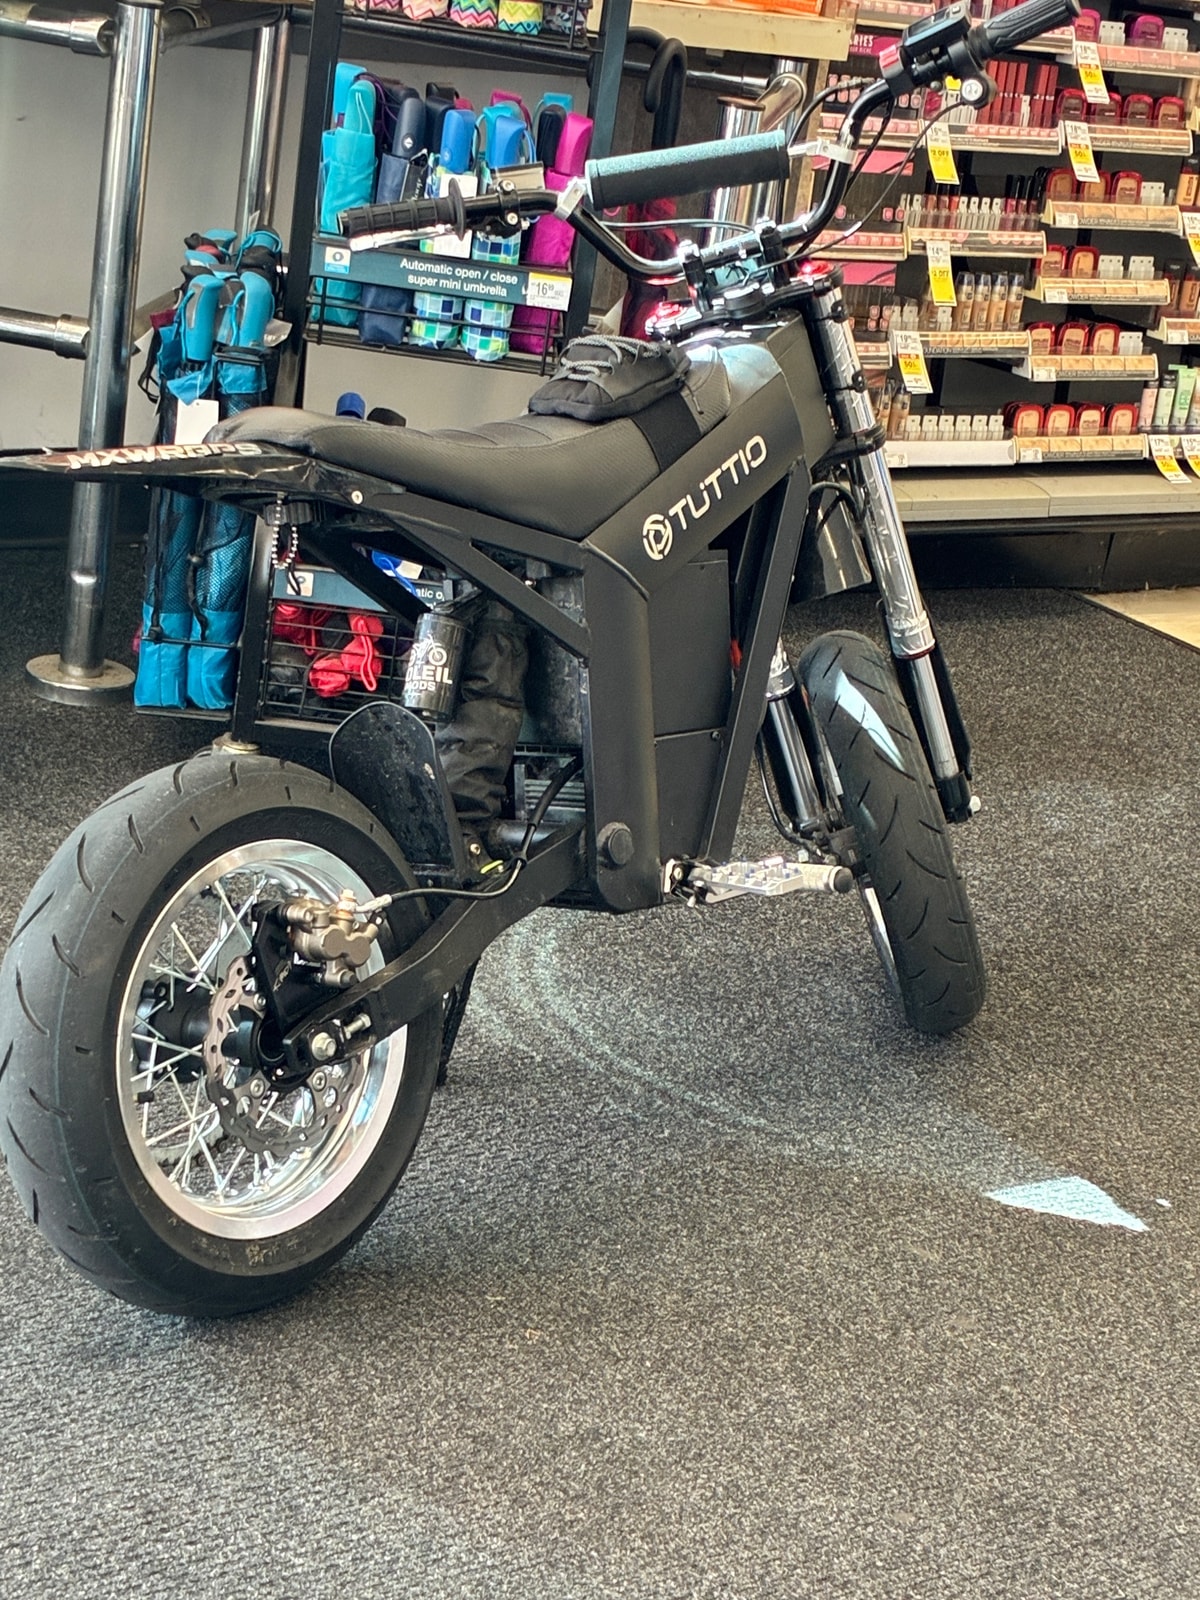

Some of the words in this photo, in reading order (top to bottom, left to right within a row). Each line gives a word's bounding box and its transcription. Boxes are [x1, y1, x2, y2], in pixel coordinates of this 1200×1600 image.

[400, 258, 453, 275] Automatic
[454, 267, 481, 279] open
[490, 271, 518, 285] close
[407, 273, 437, 287] super
[439, 278, 461, 290] mini
[463, 281, 508, 297] umbrella
[668, 435, 767, 530] TUTTIO
